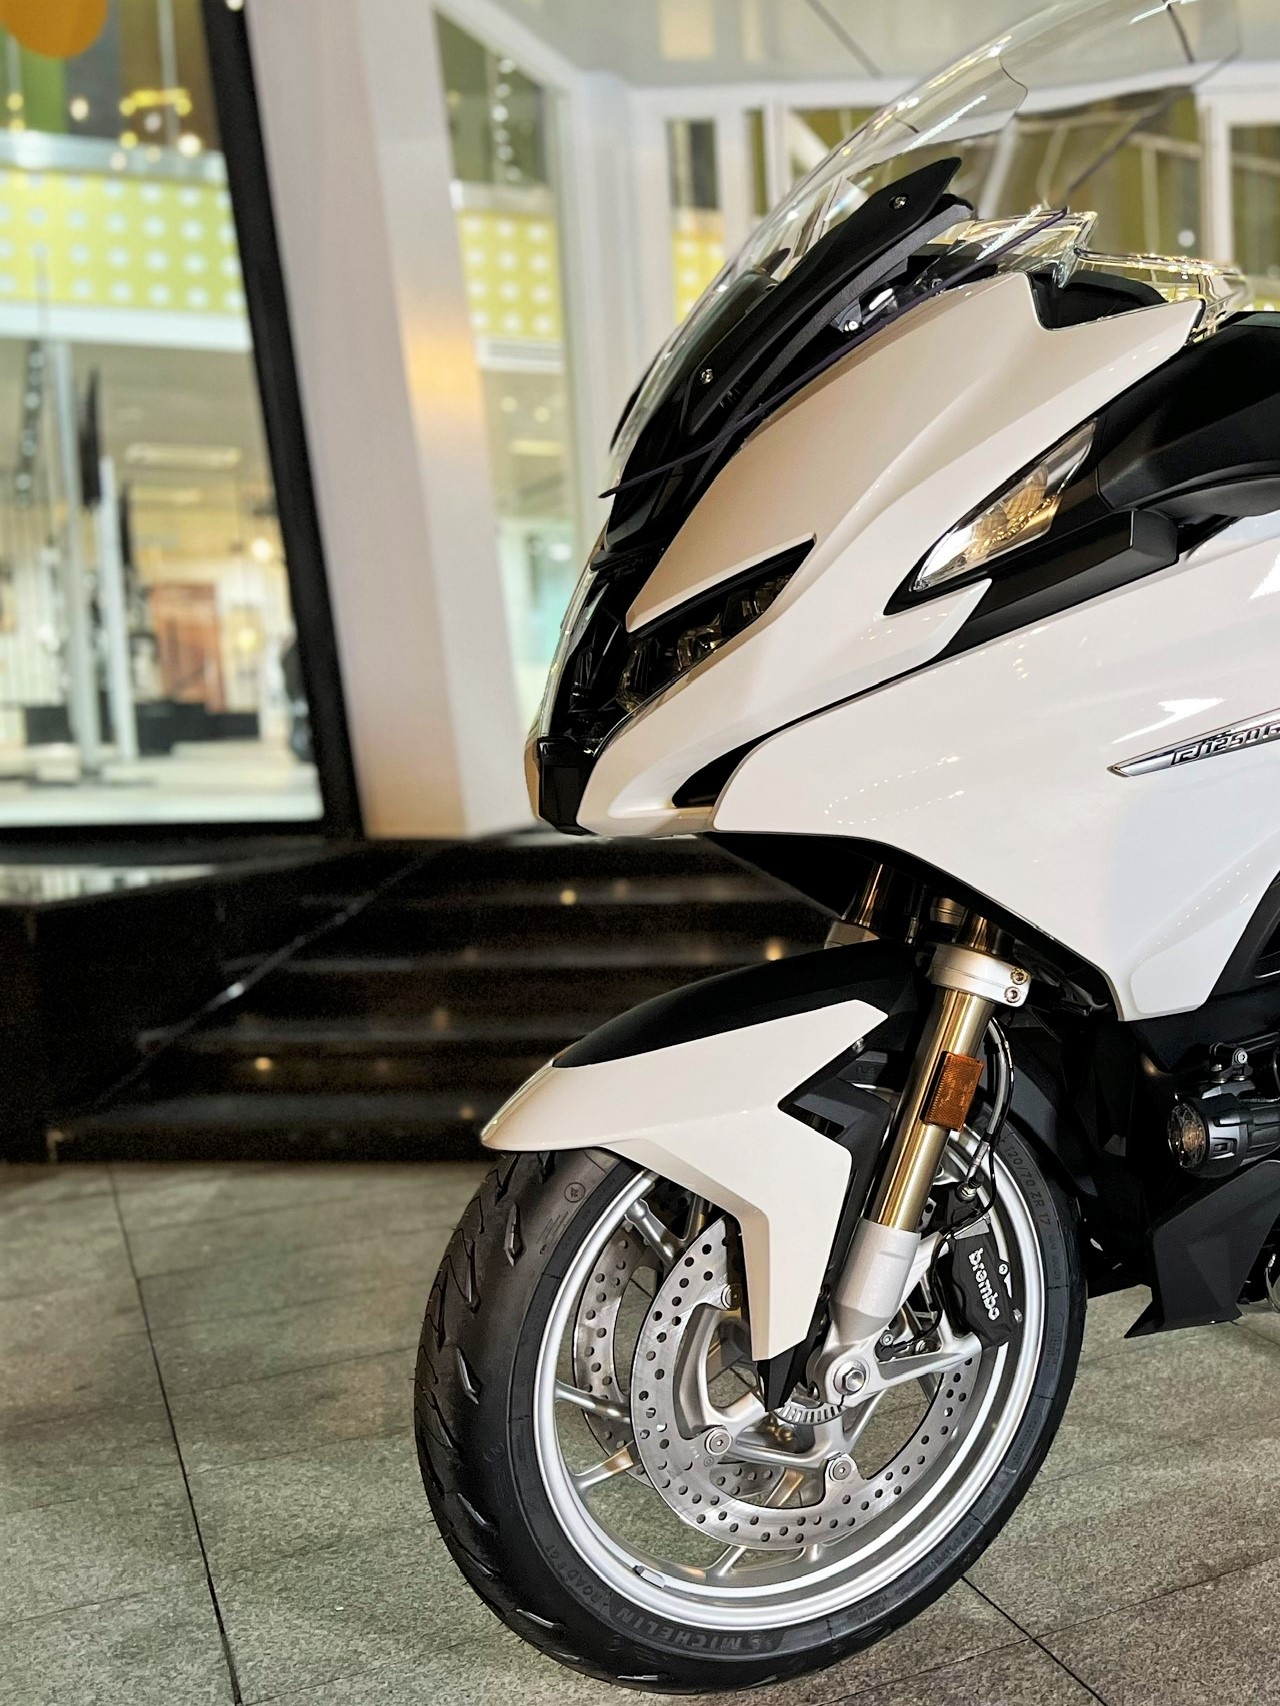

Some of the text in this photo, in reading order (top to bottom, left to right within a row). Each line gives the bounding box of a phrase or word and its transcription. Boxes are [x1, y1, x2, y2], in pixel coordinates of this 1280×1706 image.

[1005, 1146, 1036, 1187] 120/70
[1038, 1212, 1051, 1225] 17
[968, 1247, 1000, 1321] brembo
[616, 1606, 742, 1651] MICHELIN
